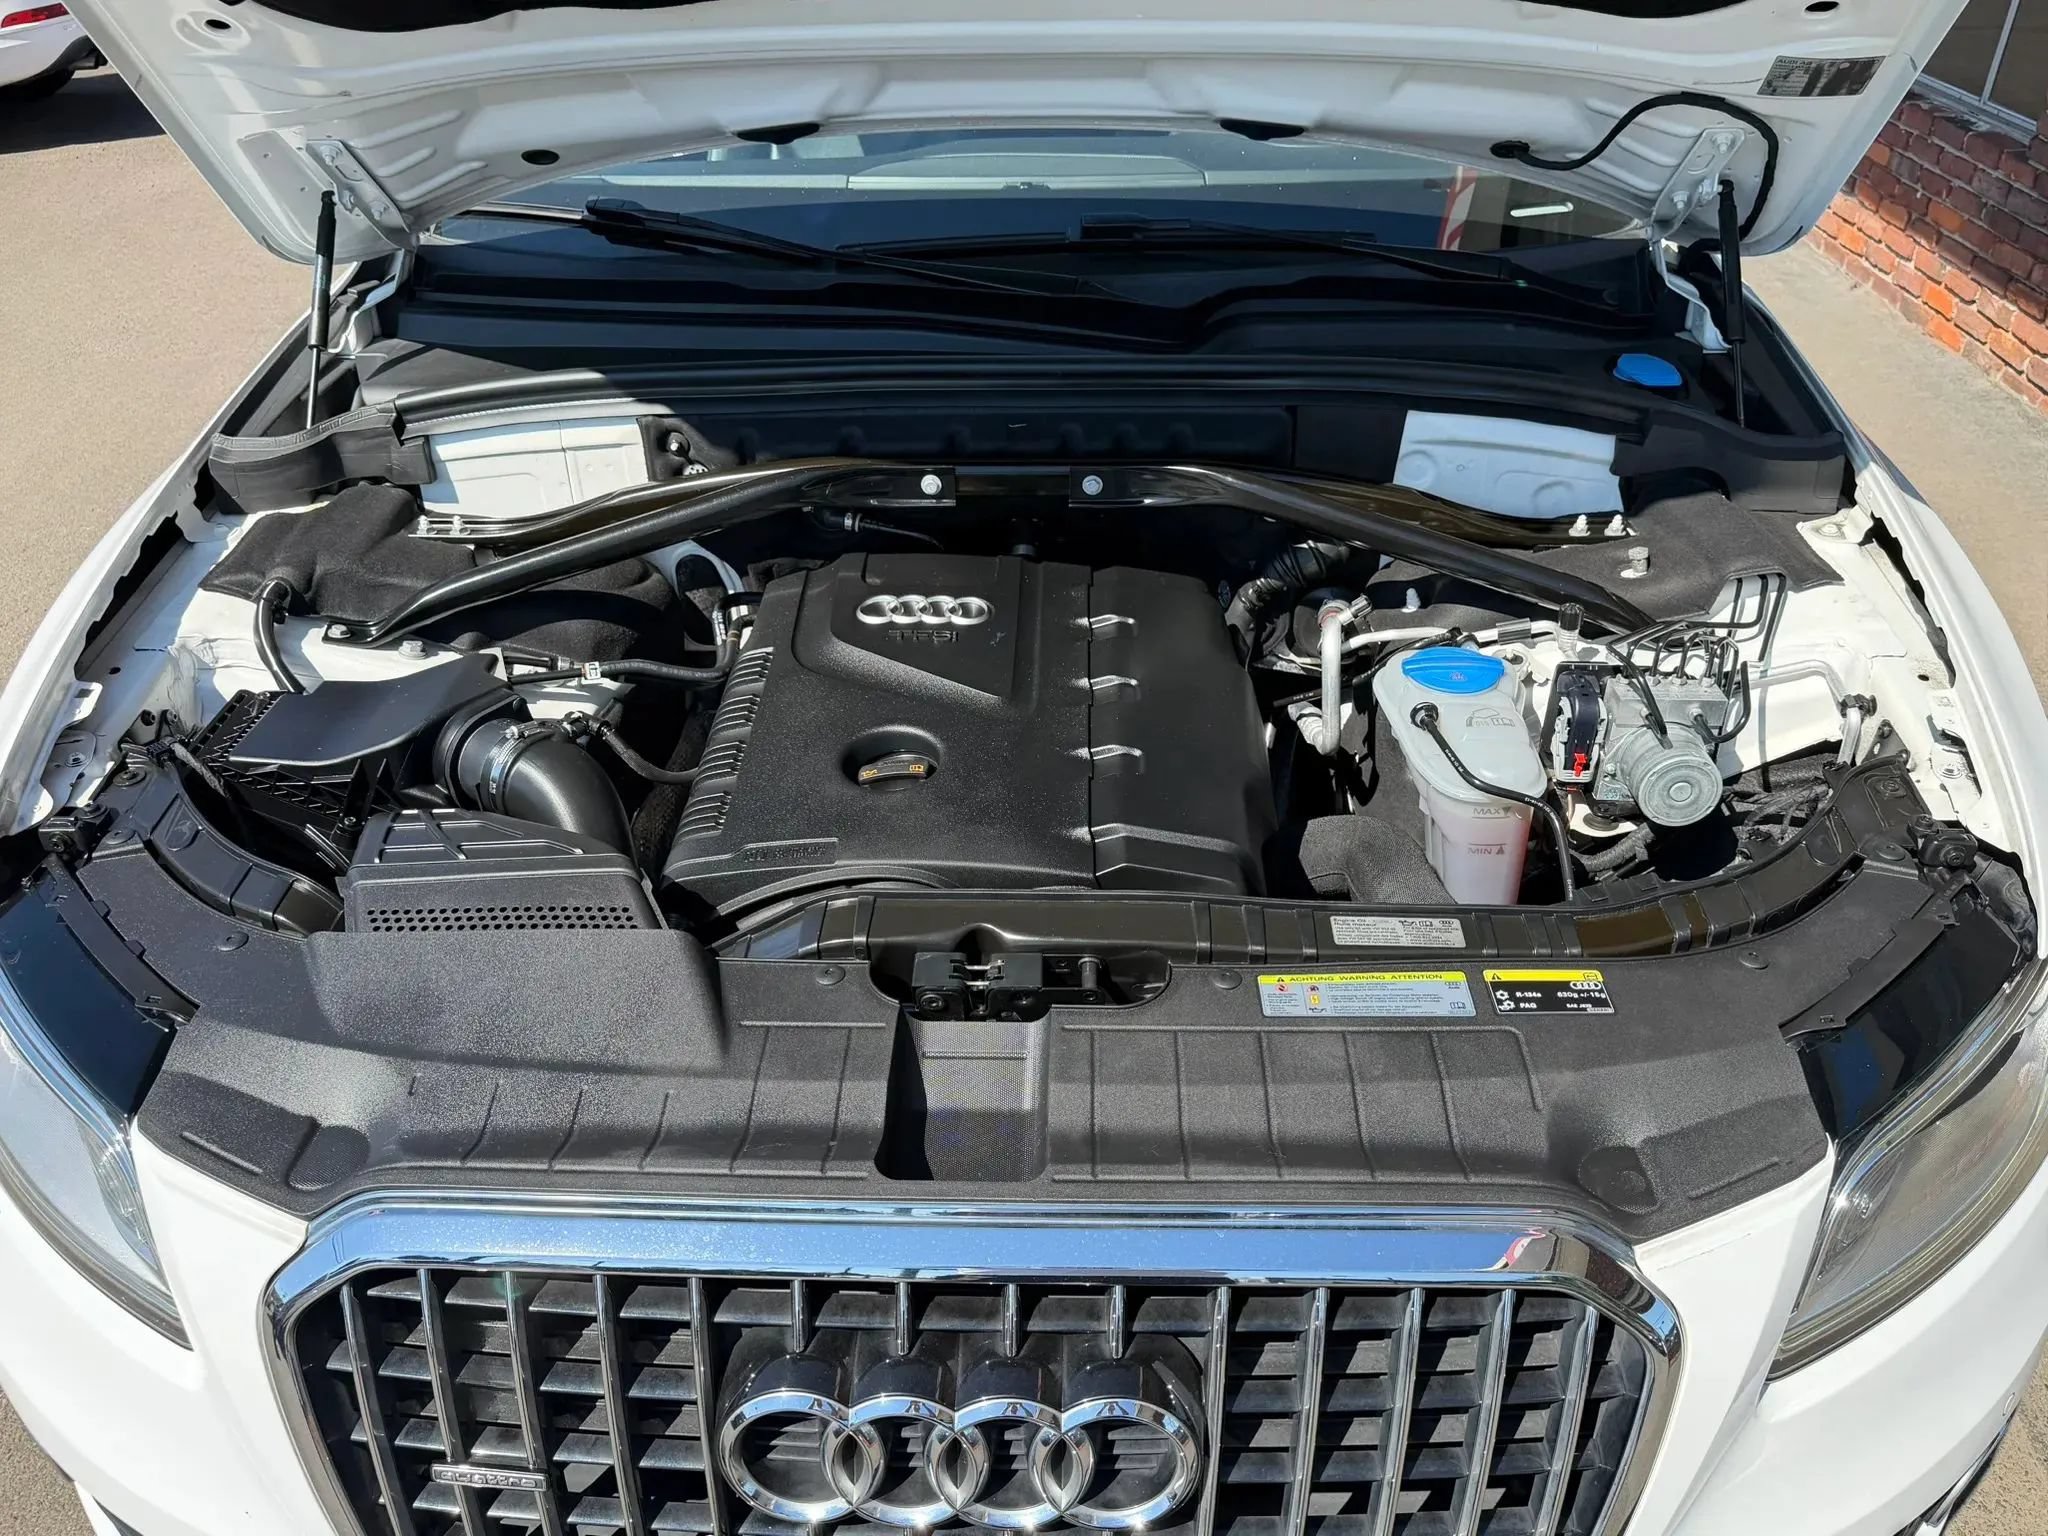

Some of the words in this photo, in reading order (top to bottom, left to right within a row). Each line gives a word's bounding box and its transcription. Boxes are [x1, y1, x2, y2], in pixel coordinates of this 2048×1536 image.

[888, 629, 959, 642] TFSI
[1473, 807, 1501, 815] MAX
[1468, 847, 1493, 855] MIN
[441, 1471, 536, 1487] quattro
